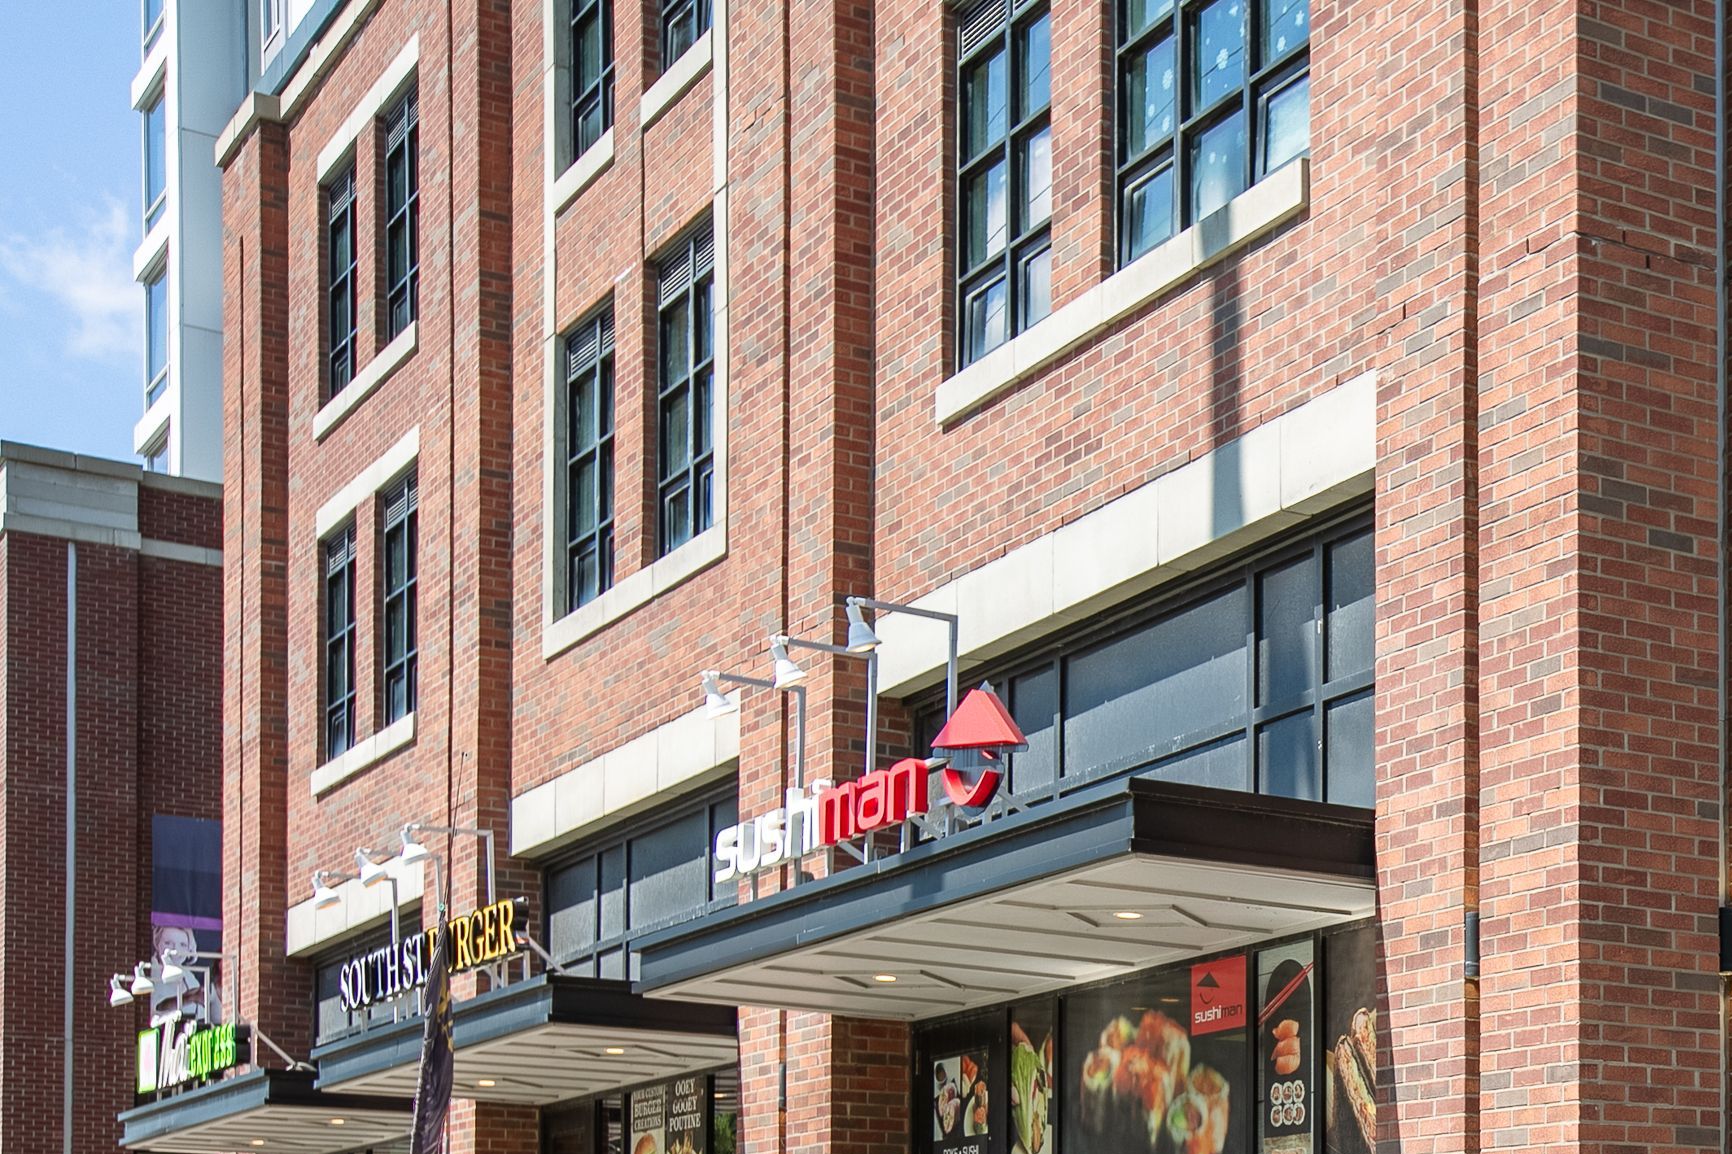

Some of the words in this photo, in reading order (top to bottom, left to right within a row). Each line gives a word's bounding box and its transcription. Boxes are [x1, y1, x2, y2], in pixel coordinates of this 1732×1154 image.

[714, 757, 930, 884] sushiman
[339, 943, 400, 1013] SOUTH
[1194, 1003, 1243, 1024] sushiman
[675, 1078, 696, 1097] OOEY
[634, 1098, 662, 1118] BURGER
[672, 1096, 698, 1115] GOOEY
[669, 1113, 701, 1132] POUTINE
